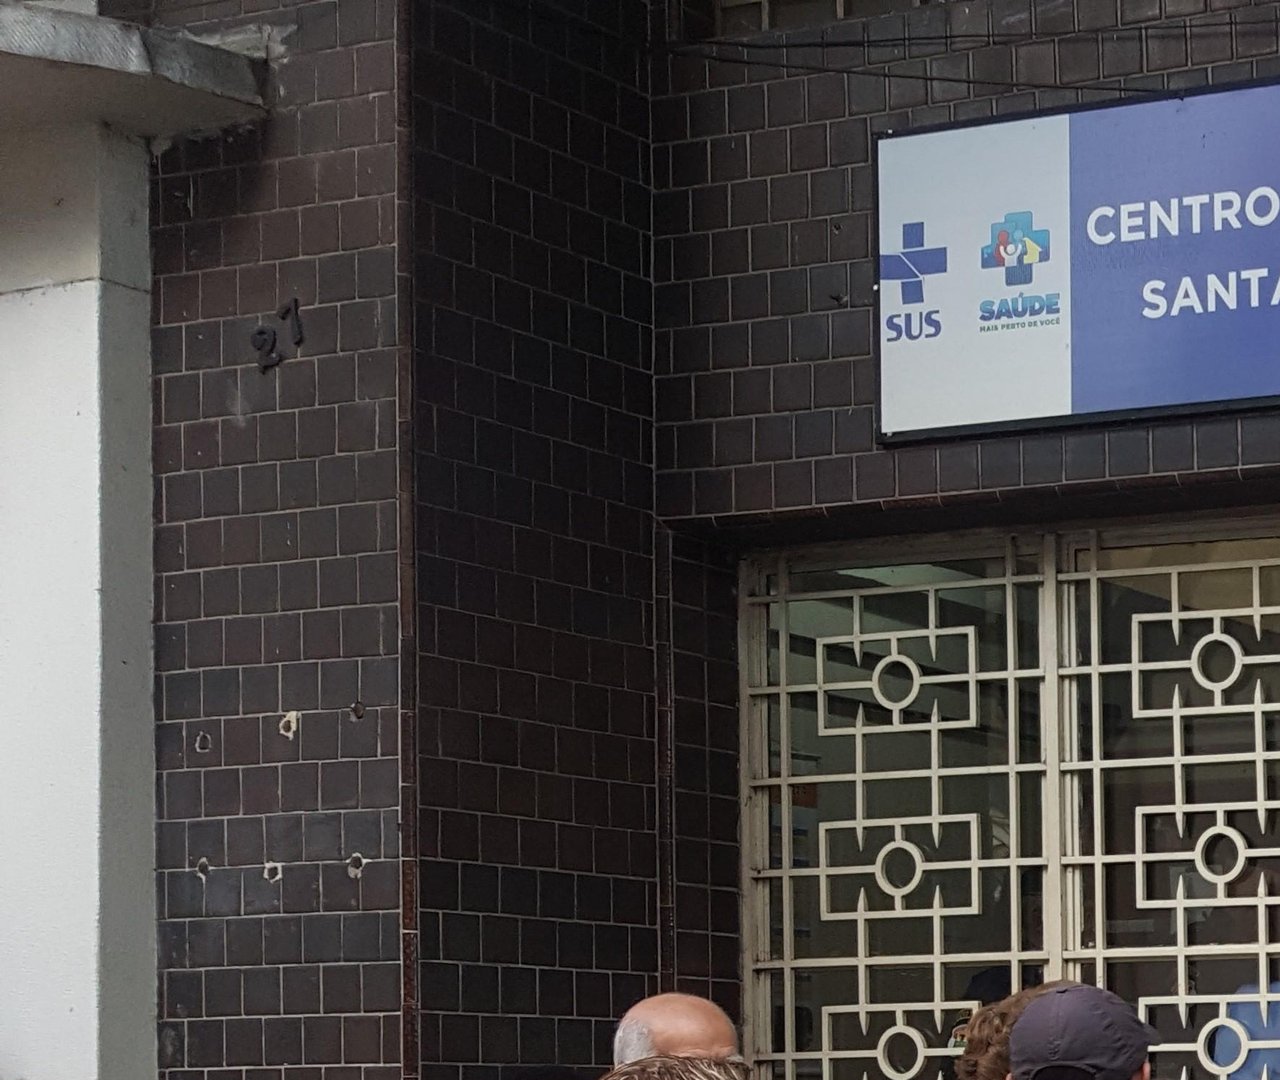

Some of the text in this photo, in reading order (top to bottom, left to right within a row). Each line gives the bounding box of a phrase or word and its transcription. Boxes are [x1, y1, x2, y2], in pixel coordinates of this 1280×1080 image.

[1086, 186, 1280, 246] CENTRO
[979, 292, 1061, 322] SAÚDE
[251, 298, 304, 375] 27
[886, 310, 942, 343] SUS
[979, 317, 1061, 333] MAIS PERTO DE VOCÊ
